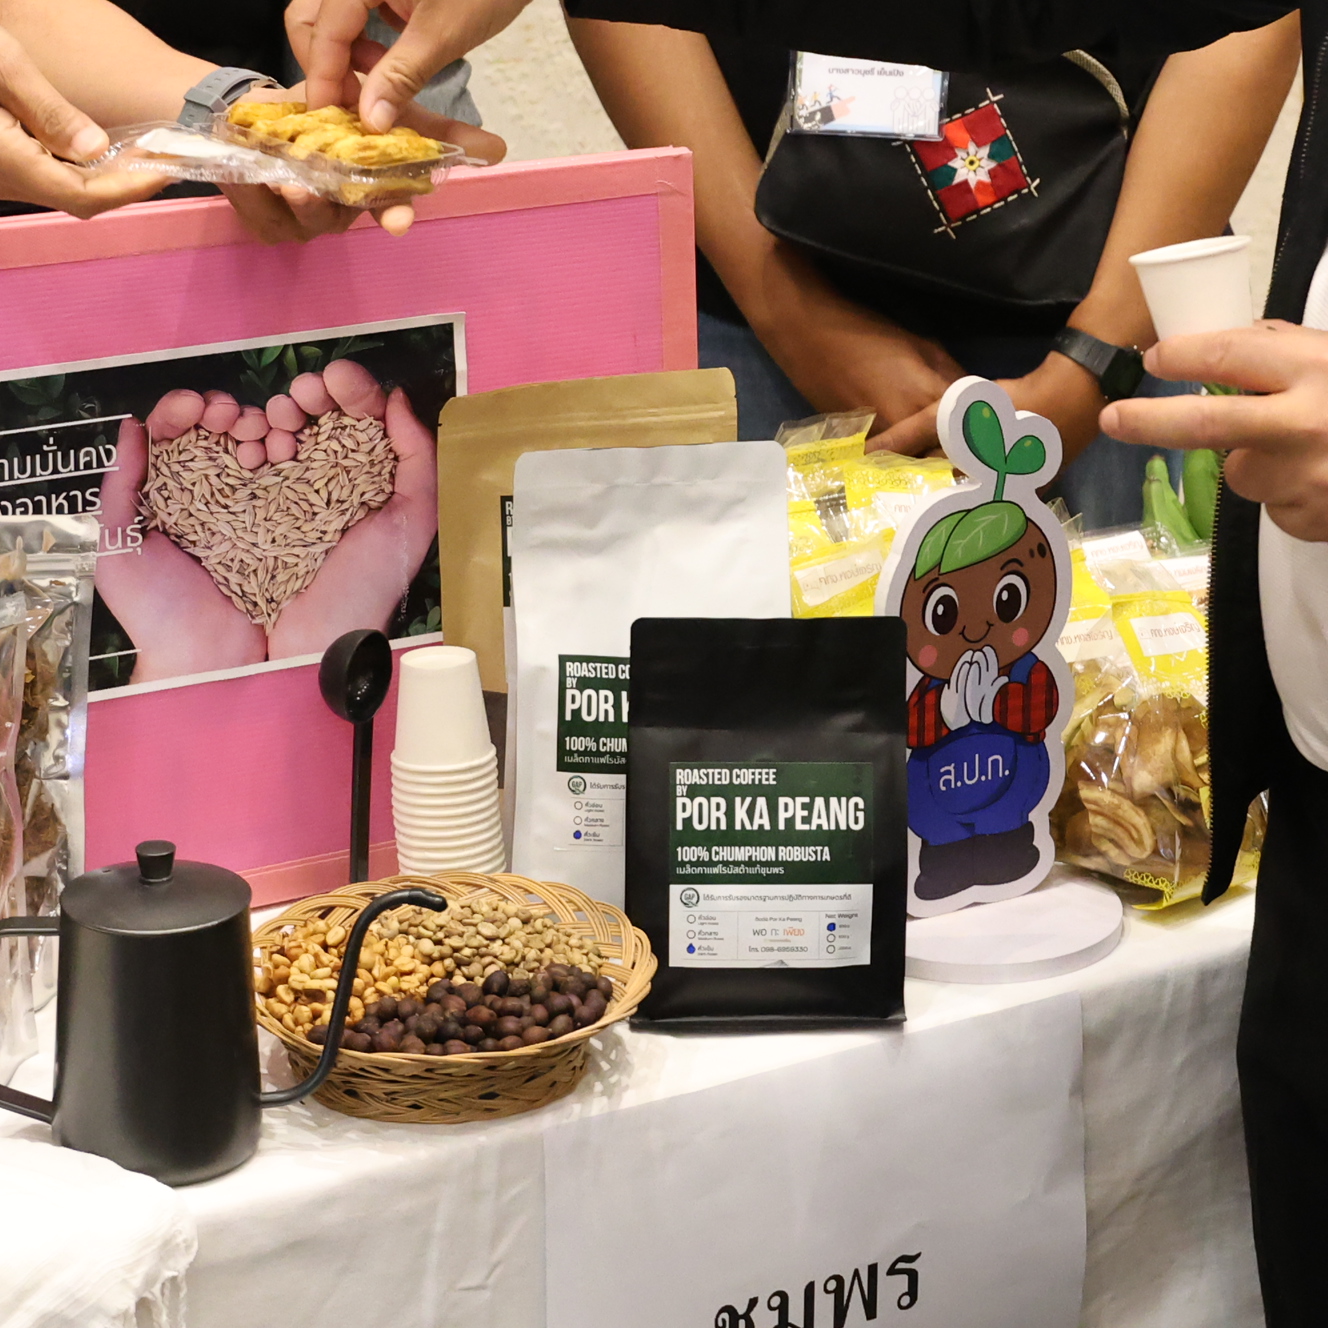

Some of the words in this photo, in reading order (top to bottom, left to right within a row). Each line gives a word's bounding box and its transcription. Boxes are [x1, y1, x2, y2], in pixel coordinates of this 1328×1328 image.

[565, 662, 616, 679] ROASTED
[566, 677, 577, 688] BY
[564, 688, 615, 722] POR
[564, 736, 597, 752] 100%
[676, 768, 730, 785] ROASTED
[732, 768, 777, 785] COFFEE
[939, 752, 1010, 791] ส.ป.ก.
[676, 785, 688, 797] BY
[676, 796, 727, 831] POR
[734, 796, 771, 831] KA
[778, 796, 865, 831] PEANG
[676, 846, 709, 862] 100%
[711, 846, 775, 862] CHUMPHON
[778, 846, 830, 862] ROBUSTA
